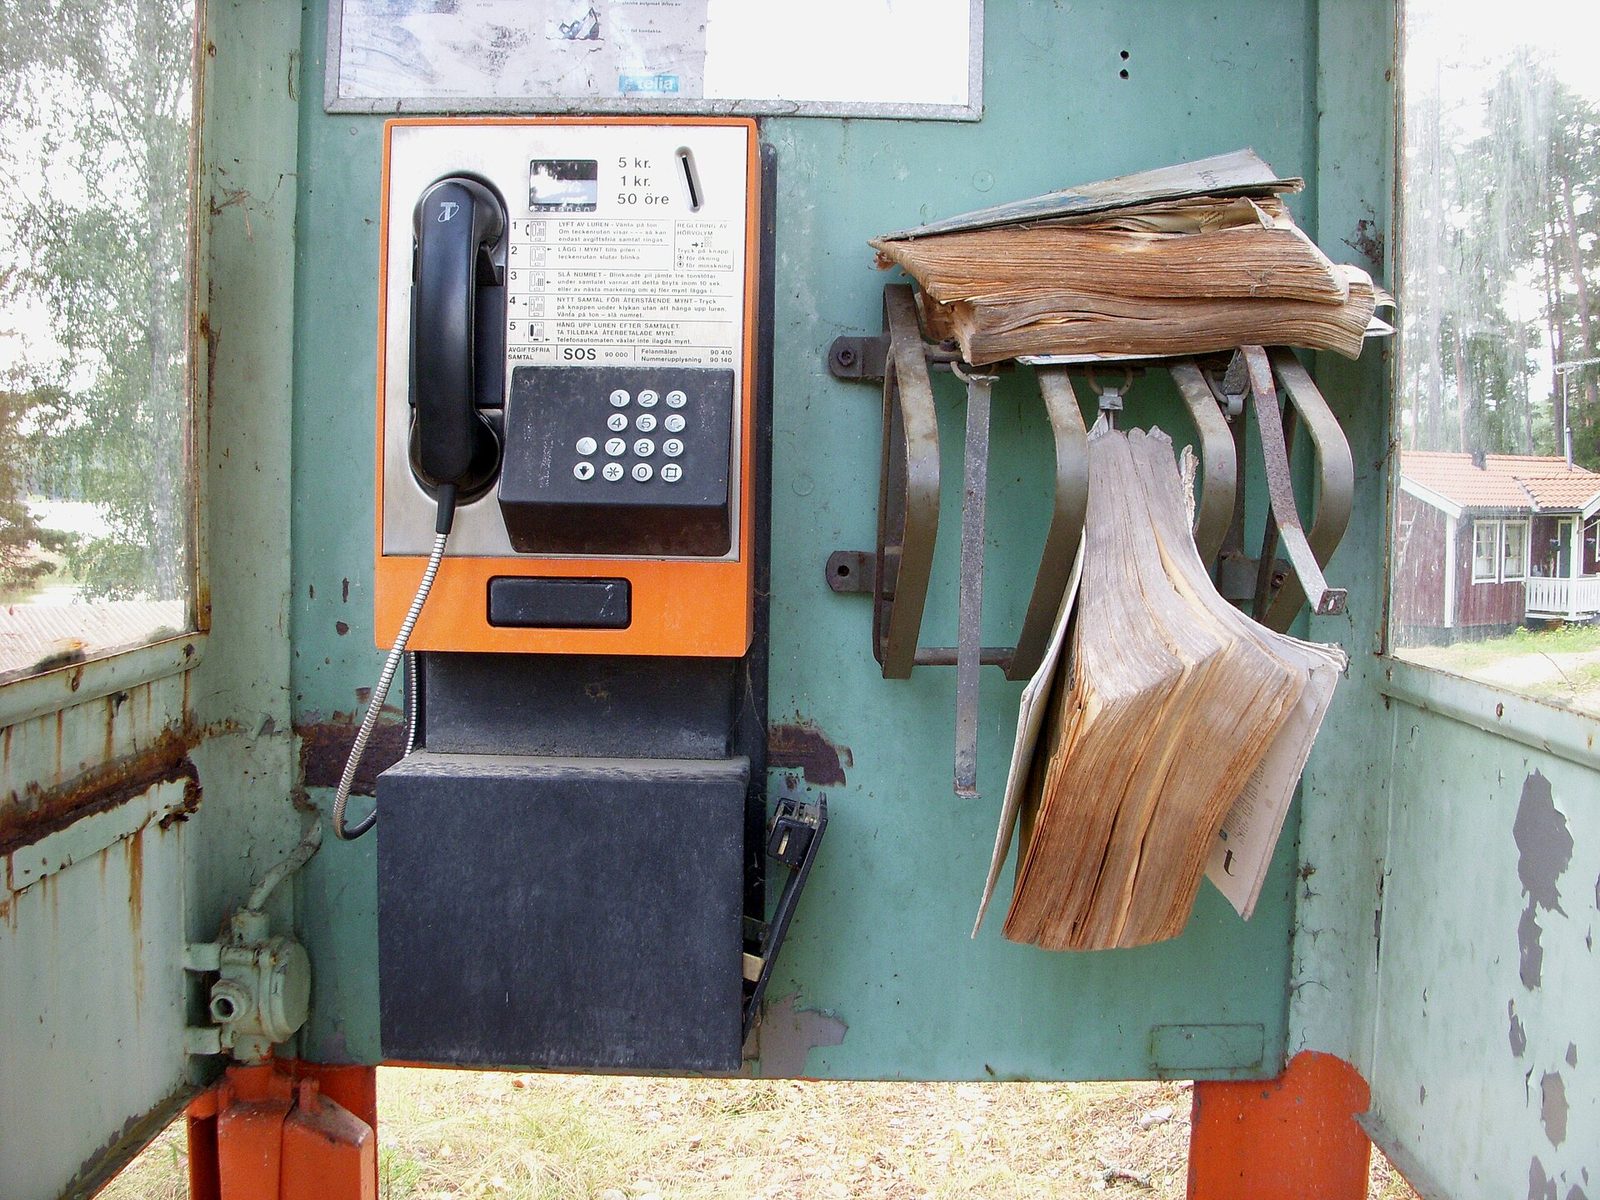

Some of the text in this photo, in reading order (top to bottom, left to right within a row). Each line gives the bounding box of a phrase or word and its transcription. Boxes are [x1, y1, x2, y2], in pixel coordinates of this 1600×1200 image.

[618, 157, 651, 168] 5 kr.
[622, 175, 651, 187] 1 kr.
[617, 192, 670, 205] 50 öre
[512, 221, 517, 230] 1
[511, 246, 518, 255] 2
[510, 271, 518, 281] 3
[509, 296, 516, 305] 4
[509, 321, 516, 331] 5
[563, 347, 597, 361] SOS
[641, 356, 702, 364] Nummerupplysning
[642, 393, 653, 405] 2
[671, 393, 682, 405] 3
[611, 417, 622, 429] 4
[641, 417, 651, 429] 5
[610, 441, 679, 454] 7 8 9
[637, 466, 648, 478] 0
